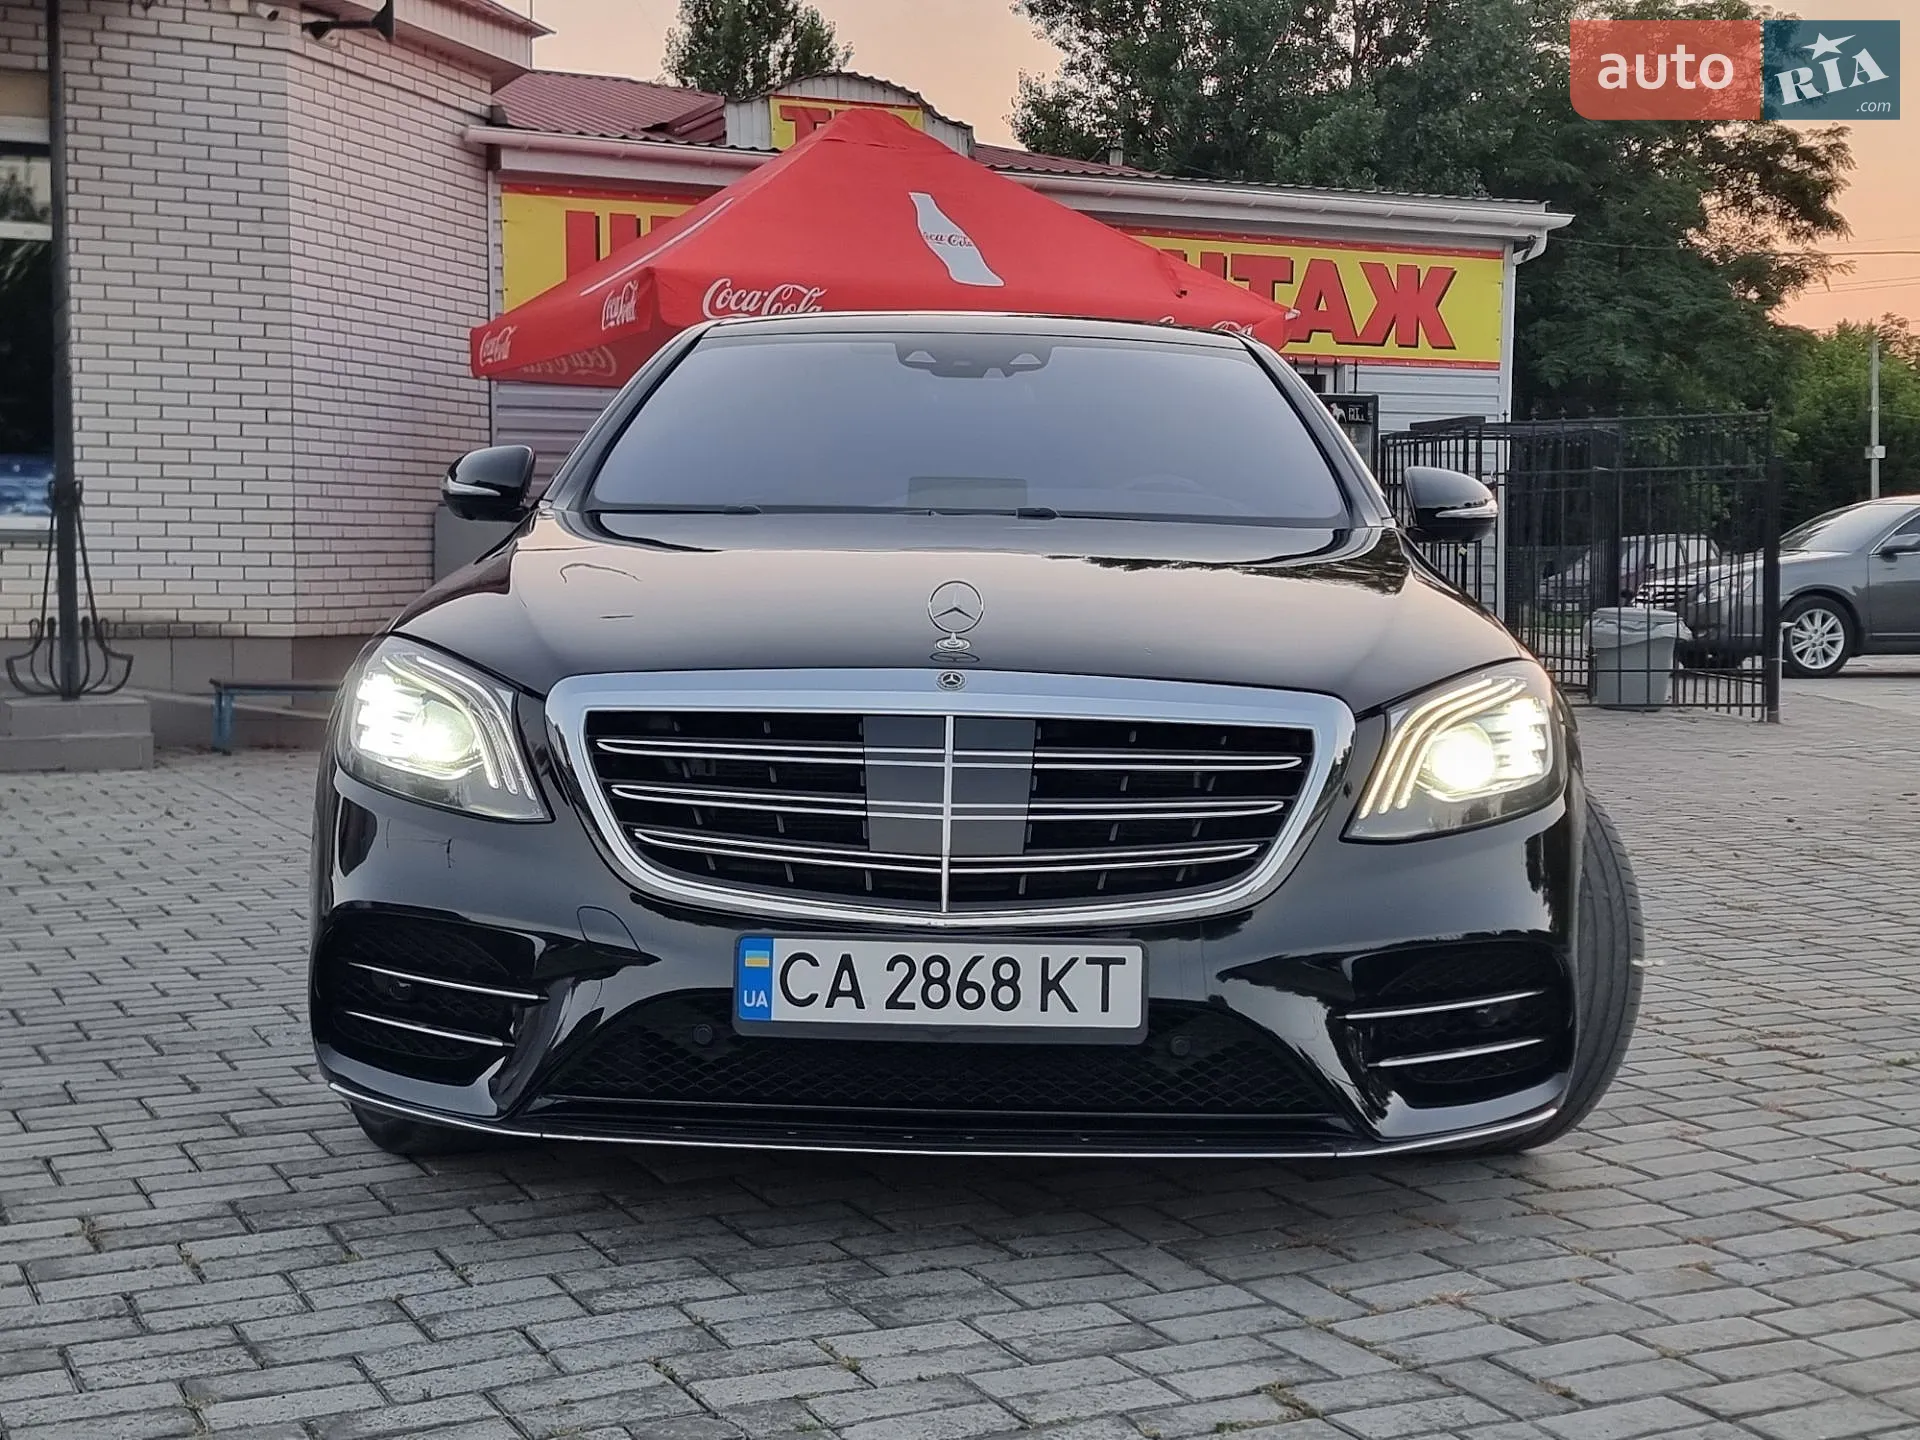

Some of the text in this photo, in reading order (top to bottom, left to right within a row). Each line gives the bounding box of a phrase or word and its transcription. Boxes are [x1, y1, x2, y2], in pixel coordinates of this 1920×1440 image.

[743, 990, 768, 1008] UA
[779, 952, 1127, 1013] CA 2868 KT
